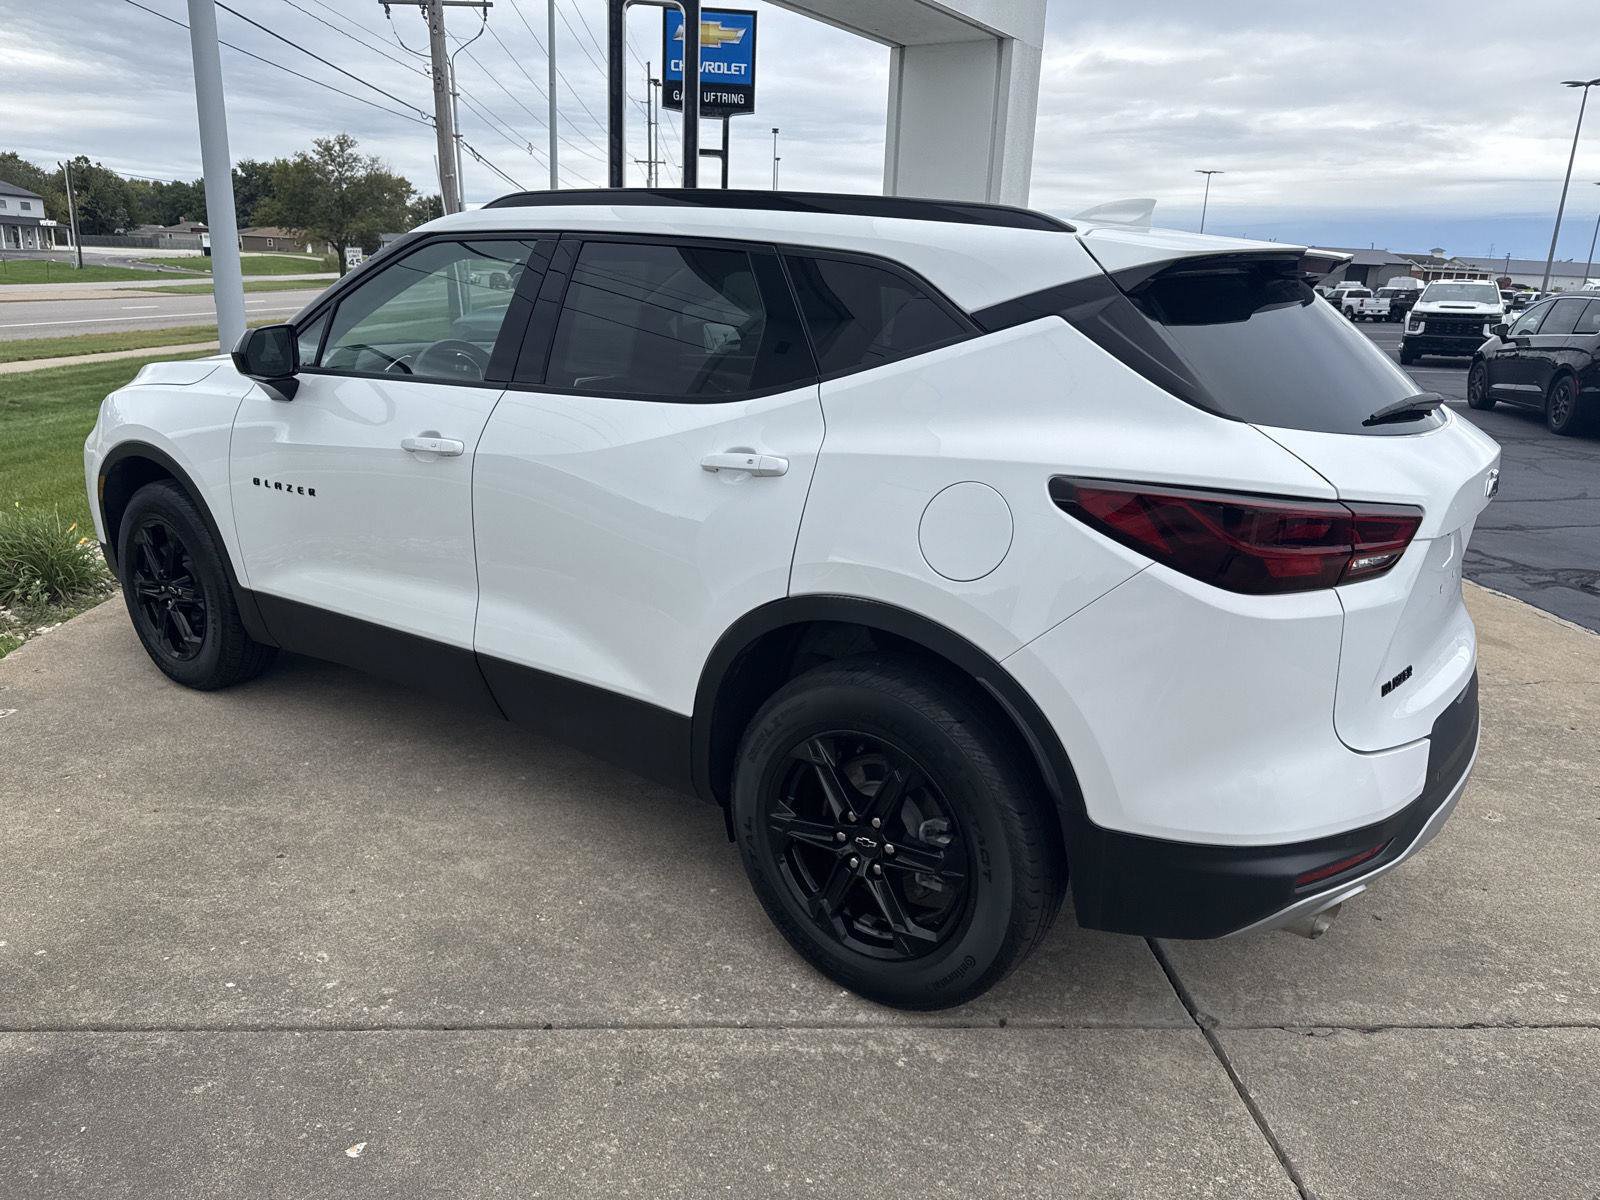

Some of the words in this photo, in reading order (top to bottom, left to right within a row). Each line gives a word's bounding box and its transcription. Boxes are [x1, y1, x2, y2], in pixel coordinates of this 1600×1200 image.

[670, 59, 747, 75] CHVROLET
[703, 92, 745, 104] UFTRING
[348, 258, 362, 266] 45
[252, 477, 317, 497] BLAZER
